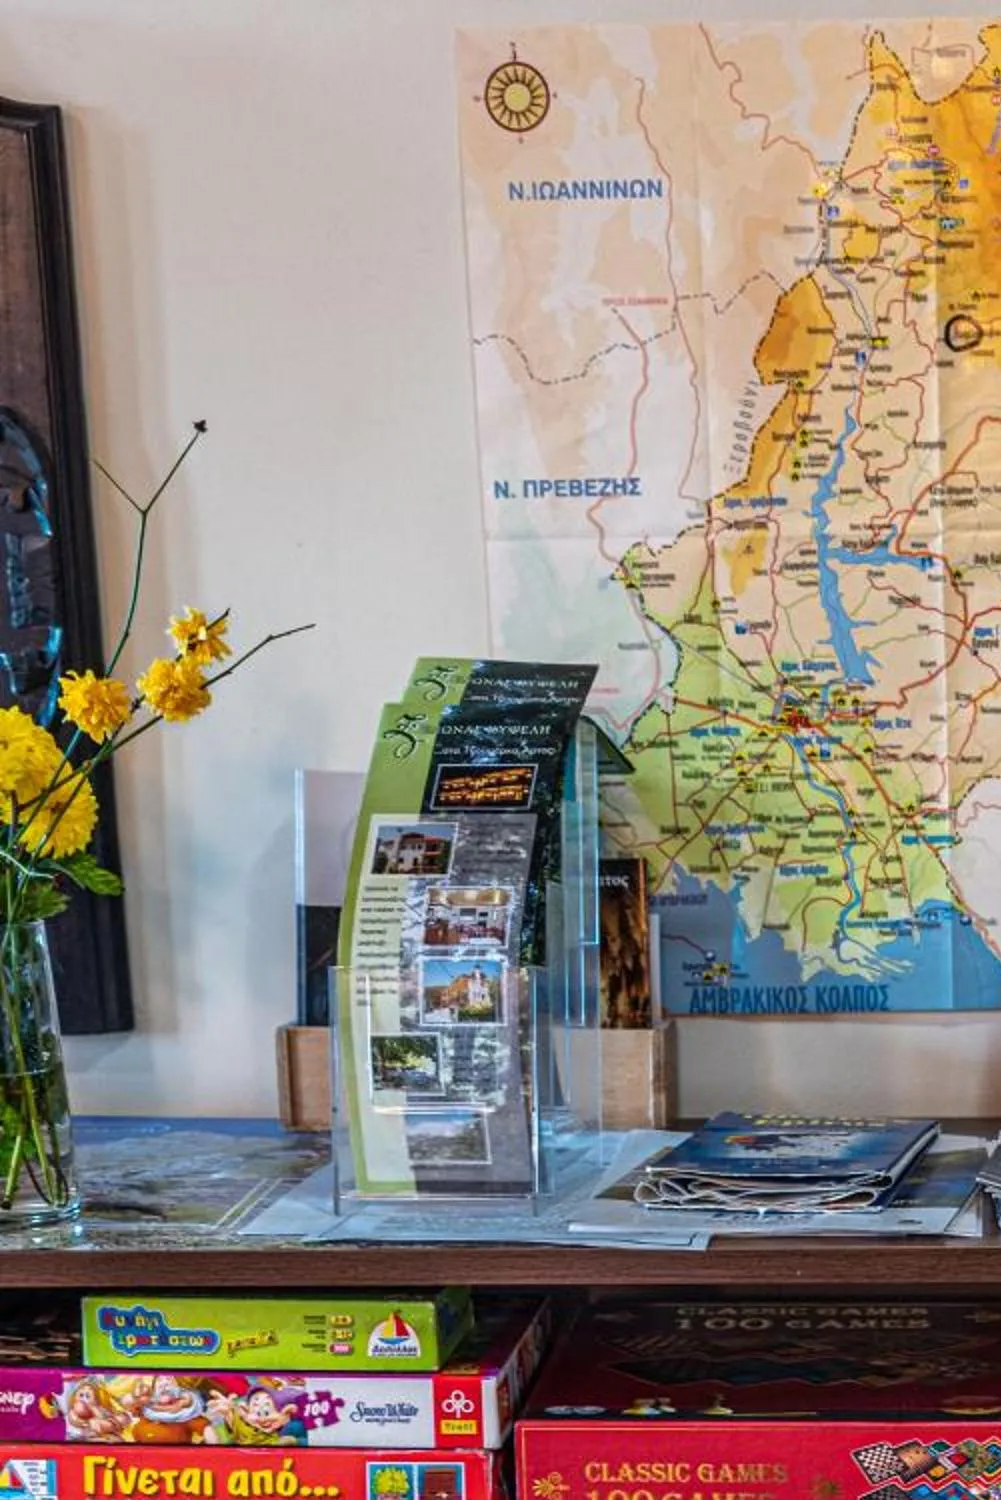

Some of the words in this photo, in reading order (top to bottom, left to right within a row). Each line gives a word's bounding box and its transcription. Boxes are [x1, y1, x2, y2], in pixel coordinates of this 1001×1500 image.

[522, 477, 642, 498] ΠΡΕΒΕΖΗΣ
[689, 987, 808, 1015] ΑΜΒΡΑΚΙΚΟΣ
[815, 984, 890, 1012] ΚΟΛΠΟΣ
[786, 1317, 931, 1330] GAMES
[303, 1400, 330, 1418] 100
[83, 1455, 213, 1497] Γίνεται
[584, 1462, 690, 1484] CLASSIC
[697, 1463, 788, 1484] GAMES
